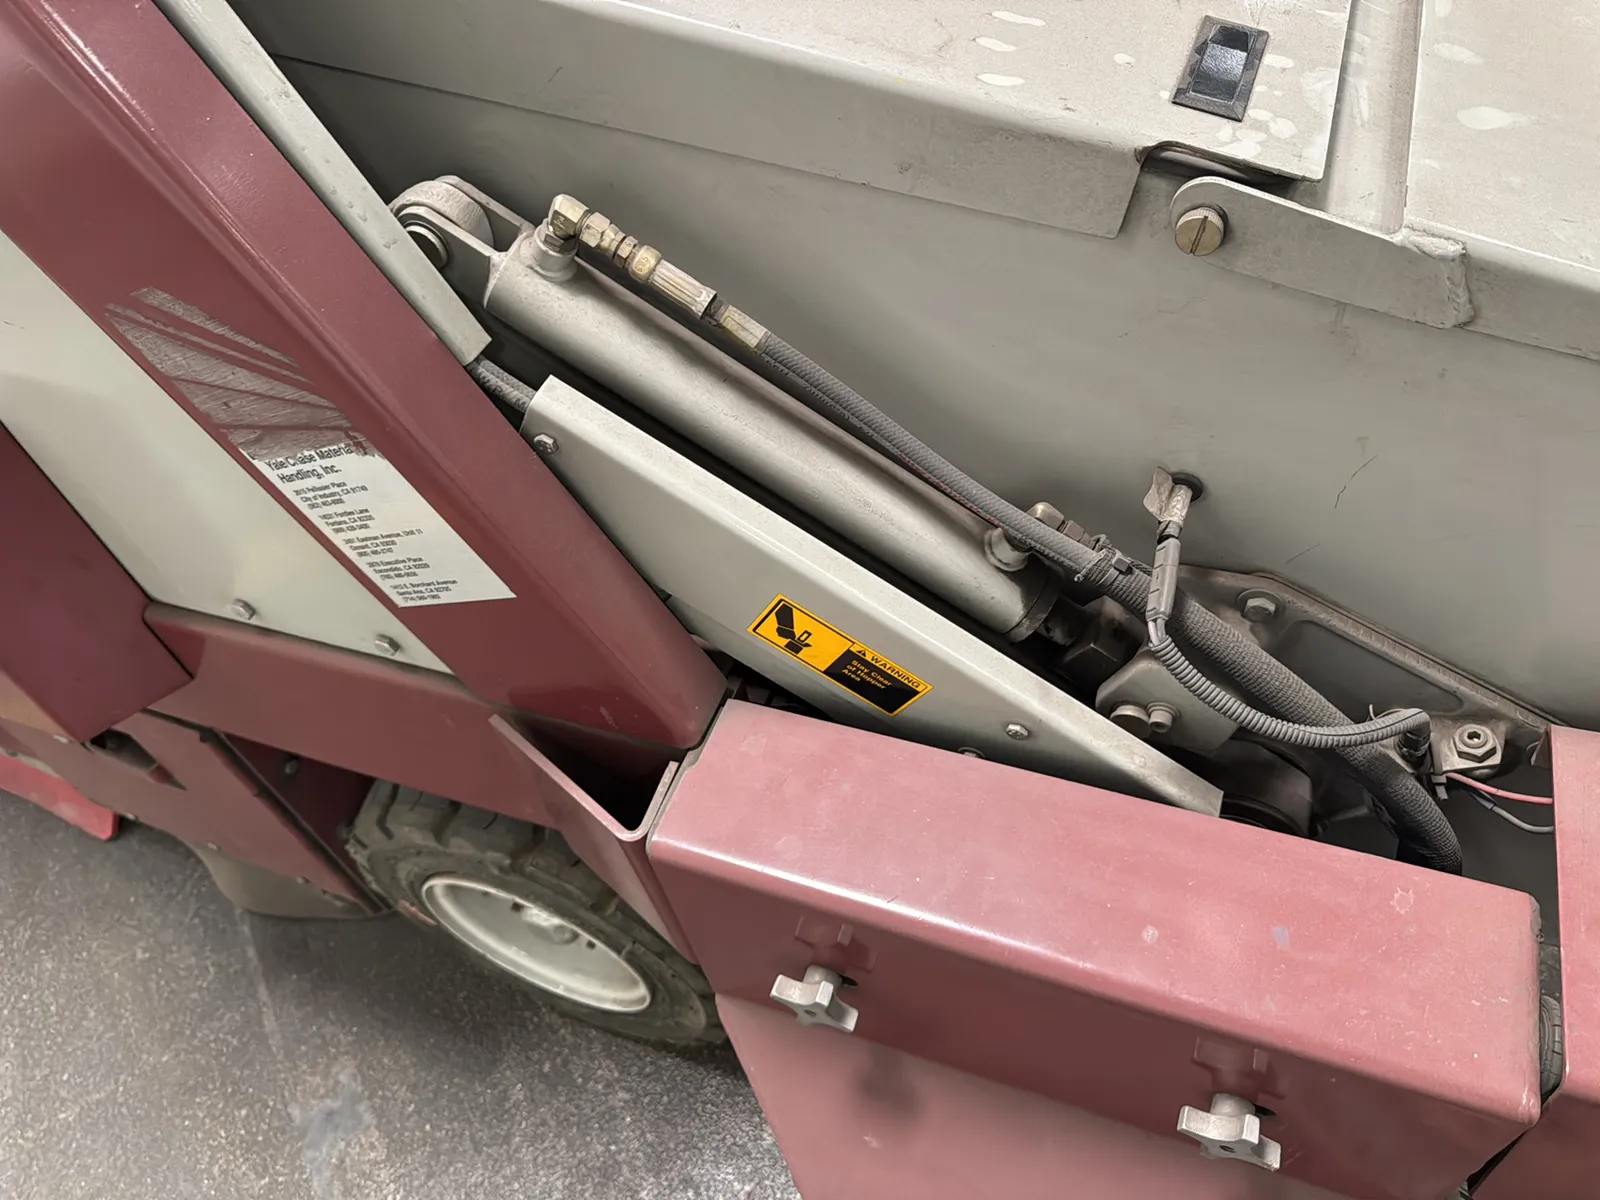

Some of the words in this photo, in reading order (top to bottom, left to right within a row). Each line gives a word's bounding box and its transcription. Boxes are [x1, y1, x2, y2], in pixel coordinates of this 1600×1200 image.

[265, 458, 288, 471] Yale
[315, 445, 353, 458] Materia
[277, 469, 324, 482] Handling,
[319, 464, 341, 474] Inc.
[841, 669, 861, 682] Area
[851, 660, 870, 673] Stay
[870, 670, 893, 687] Clear
[857, 670, 886, 689] Hopper
[870, 655, 921, 689] WARNING
